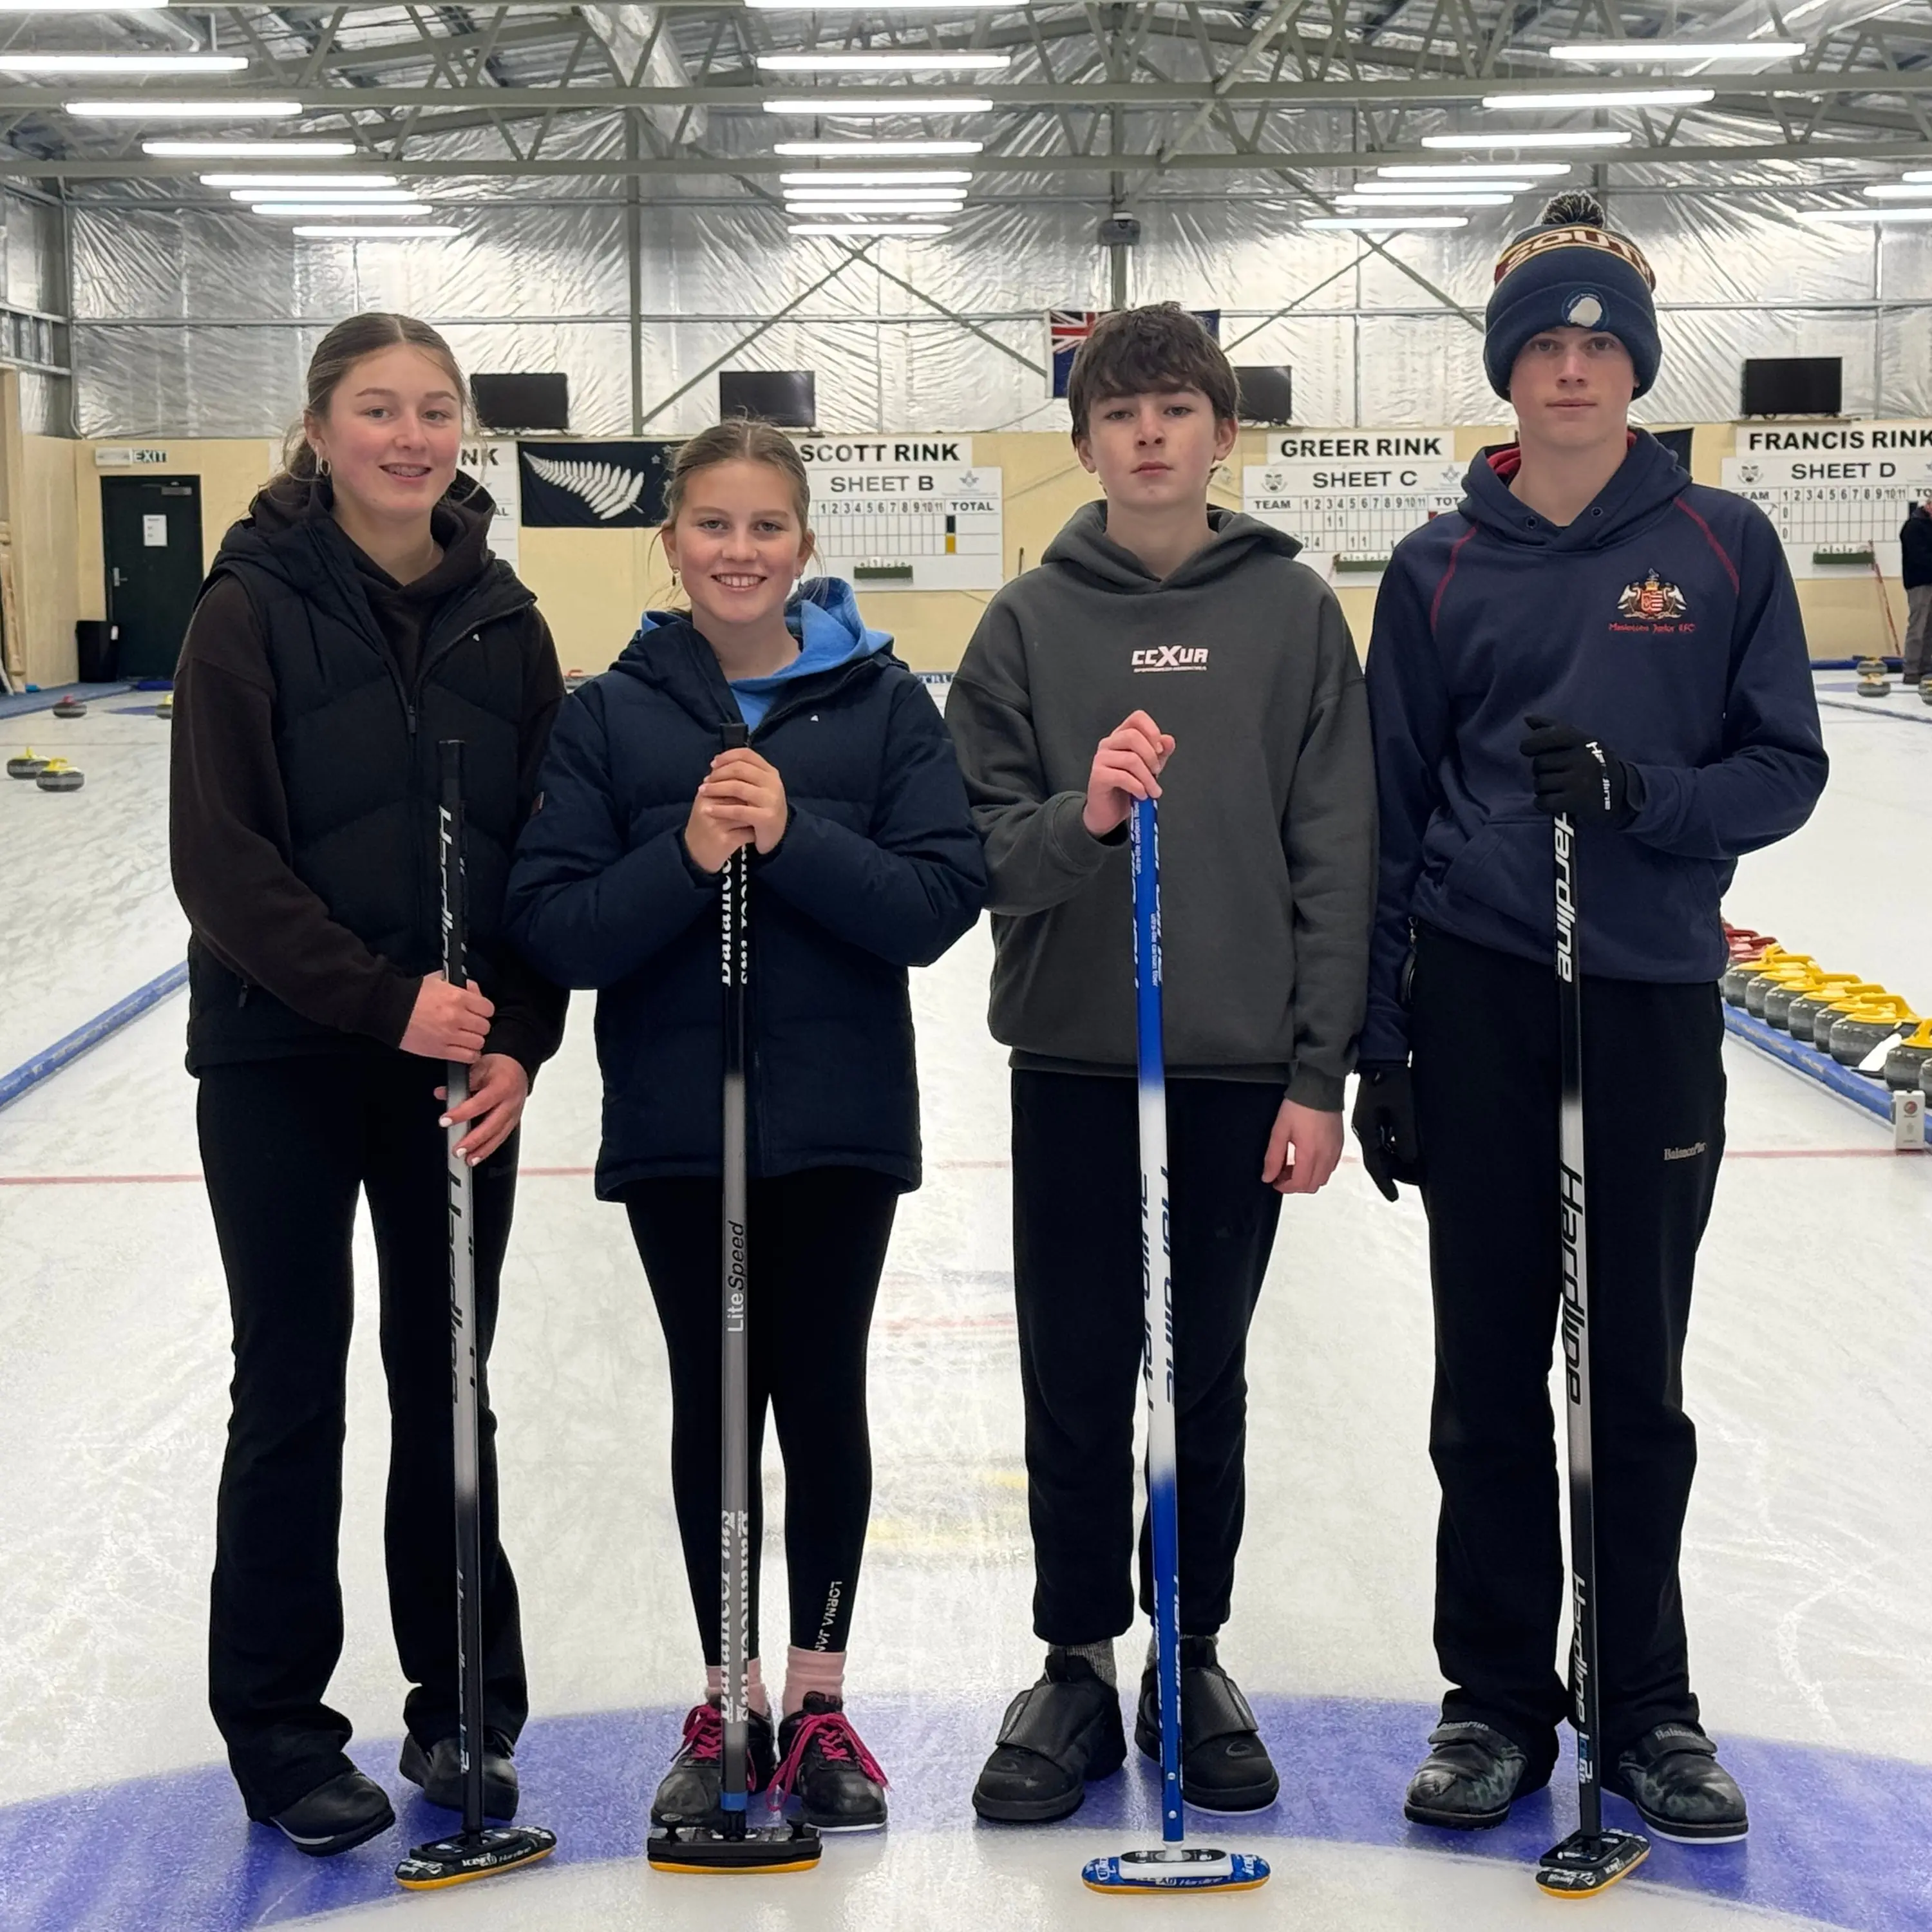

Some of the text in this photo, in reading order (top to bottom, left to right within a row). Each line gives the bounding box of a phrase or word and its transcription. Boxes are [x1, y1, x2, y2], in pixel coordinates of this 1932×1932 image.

[1281, 438, 1442, 457] GREER RINK
[1749, 430, 1932, 450] FRANCIS RINK
[134, 450, 167, 463] EXIT
[800, 443, 960, 462] SCOTT RINK
[1792, 463, 1896, 479] SHEET D
[830, 476, 934, 492] SHEET B
[1312, 471, 1417, 488] SHEET C
[1794, 490, 1801, 501] 2
[1806, 489, 1812, 500] 3
[1817, 489, 1823, 500] 4
[1830, 489, 1835, 500] 5
[1841, 489, 1847, 500] 6
[1852, 489, 1859, 499] 7
[1864, 489, 1870, 499] 8
[1876, 489, 1882, 499] 9
[832, 503, 838, 513] 2
[844, 503, 851, 513] 3
[855, 503, 861, 513] 4
[867, 503, 873, 513] 5
[878, 502, 884, 513] 6
[890, 502, 896, 513] 7
[902, 502, 908, 513] 8
[913, 502, 920, 513] 9
[952, 502, 994, 511] TOTAL
[1256, 500, 1291, 509] TEAM
[1315, 499, 1321, 509] 2
[1327, 499, 1332, 509] 3
[1338, 498, 1344, 508] 4
[1350, 498, 1356, 508] 5
[1361, 498, 1368, 508] 6
[1373, 498, 1379, 508] 7
[1385, 498, 1390, 507] 8
[1396, 498, 1402, 507] 9
[822, 1581, 842, 1626] LORNA
